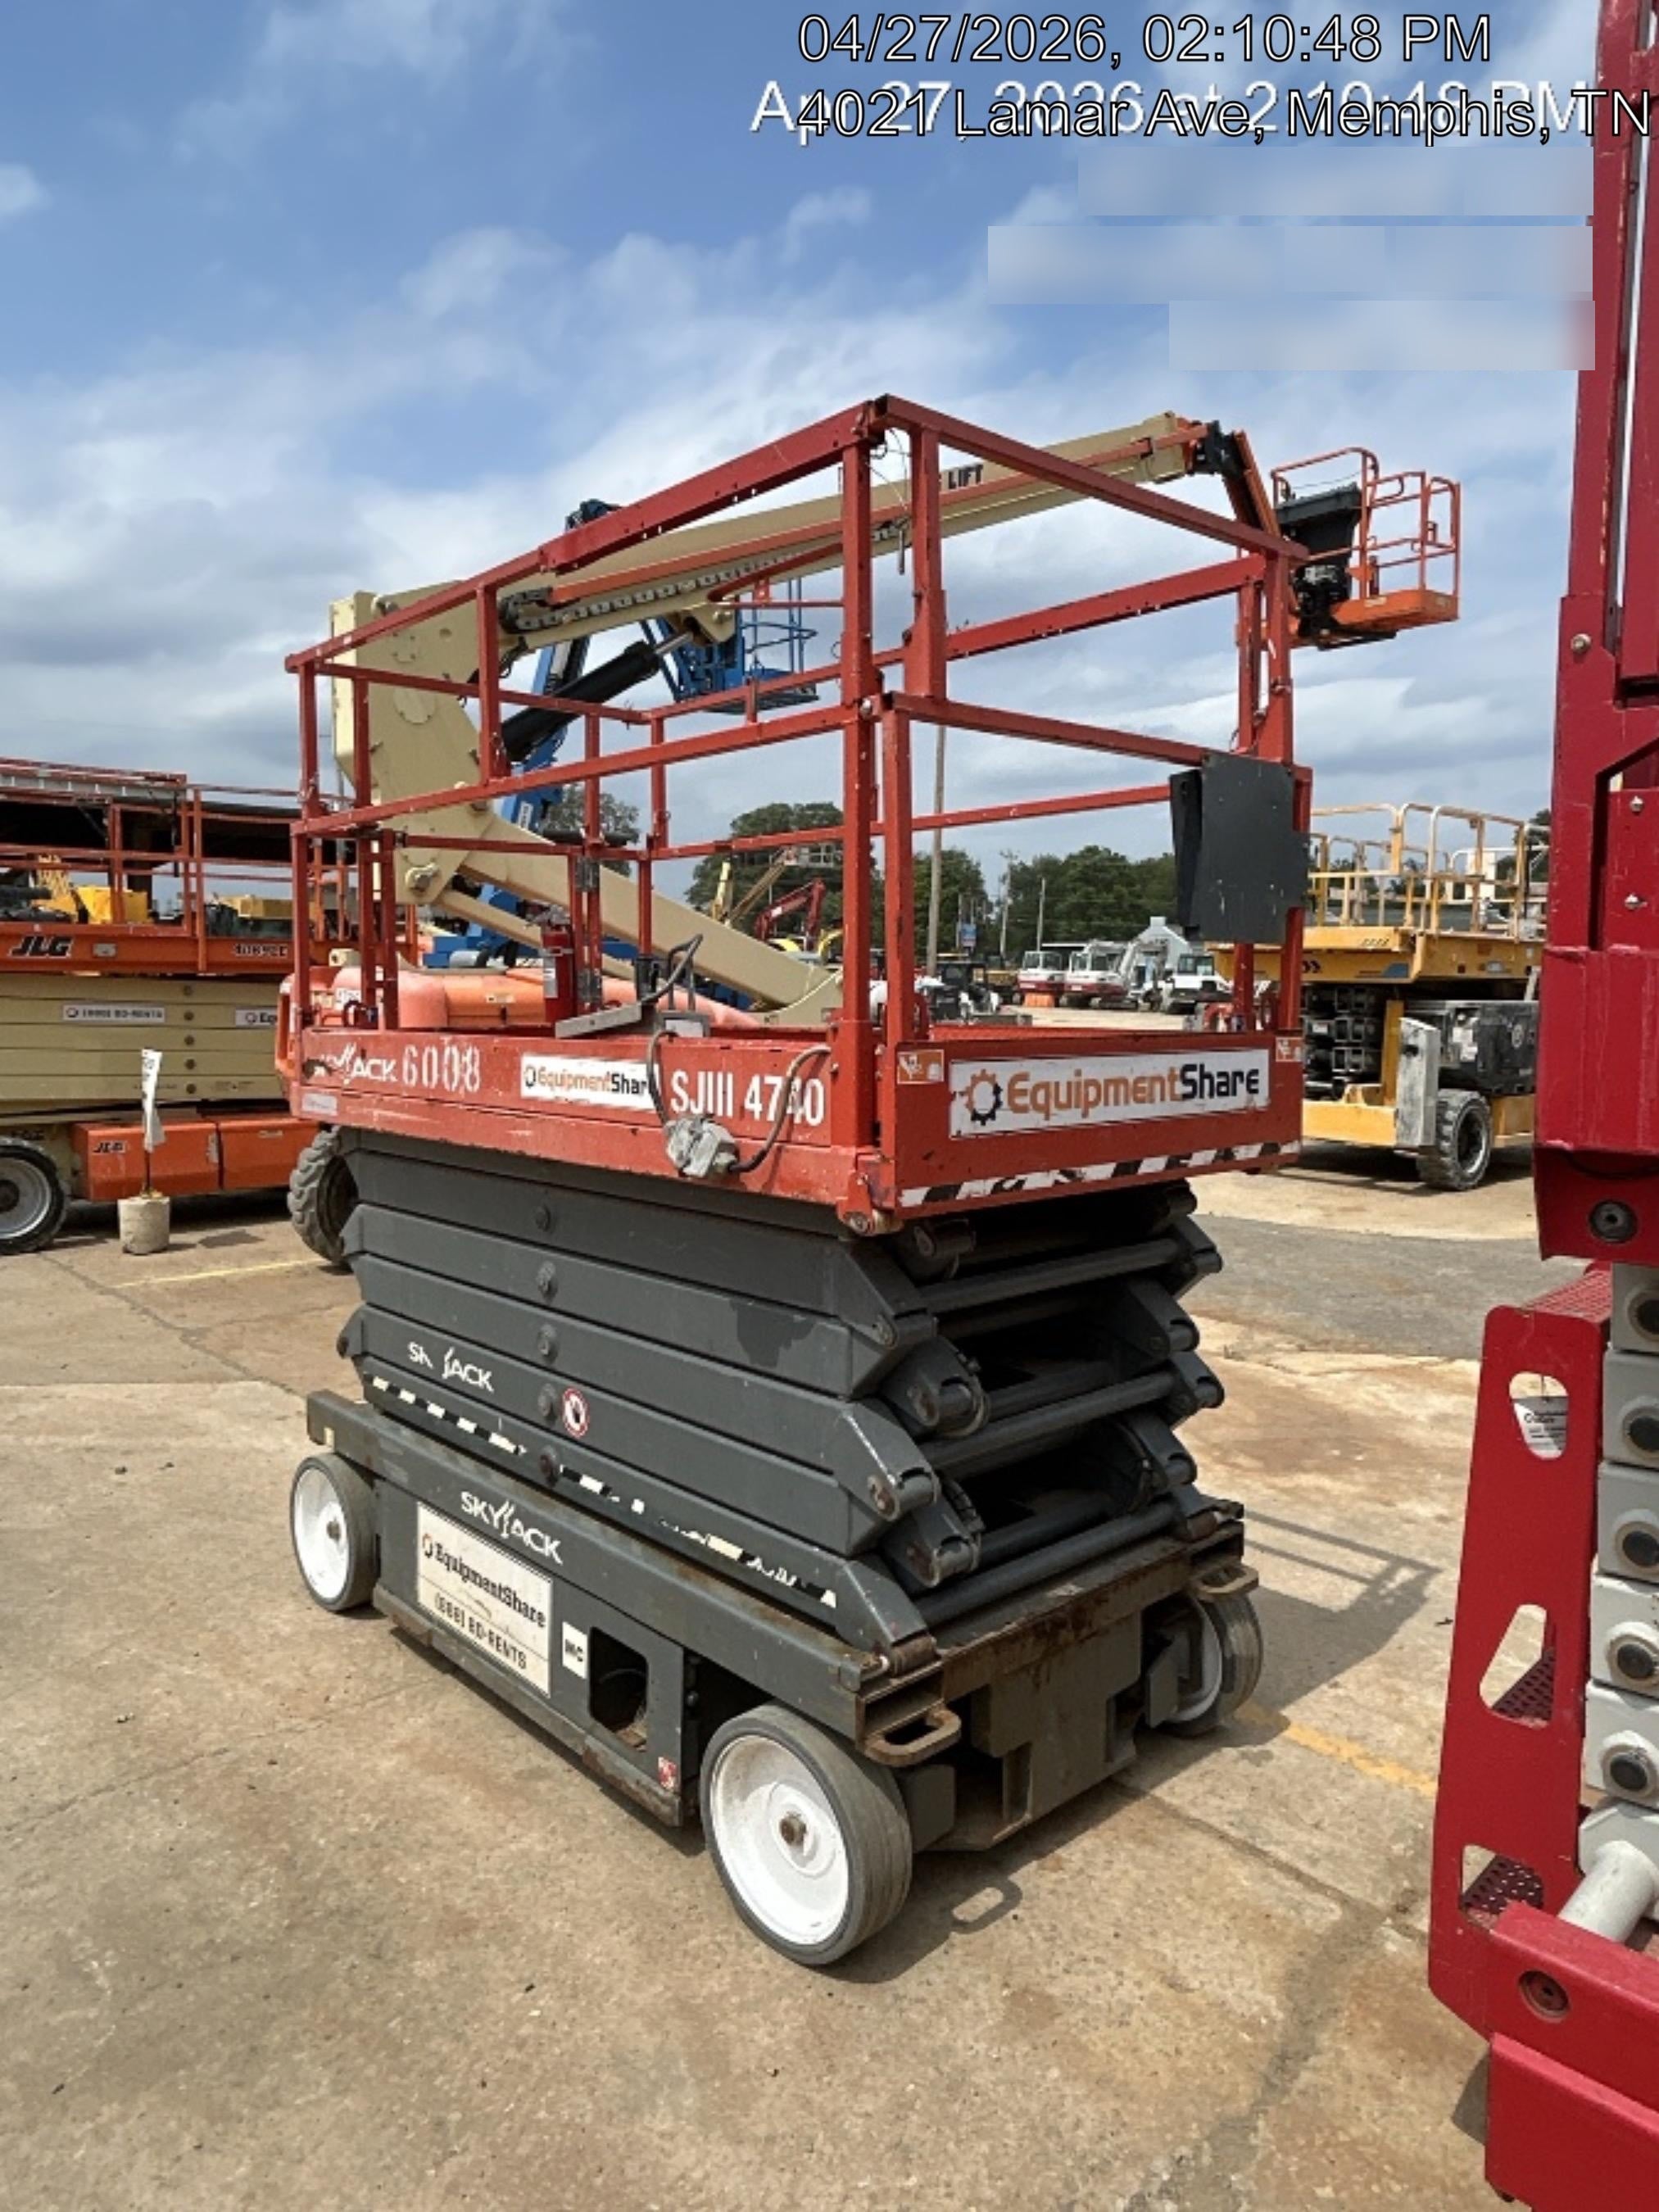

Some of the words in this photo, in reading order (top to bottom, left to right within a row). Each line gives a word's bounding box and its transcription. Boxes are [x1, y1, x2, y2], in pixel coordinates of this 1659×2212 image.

[9, 936, 73, 958] JLG
[744, 1074, 824, 1126] 4740
[1006, 1063, 1259, 1119] EquipmentShare
[460, 1491, 564, 1566] SKYJACK
[434, 1540, 546, 1629] EquipmentShare
